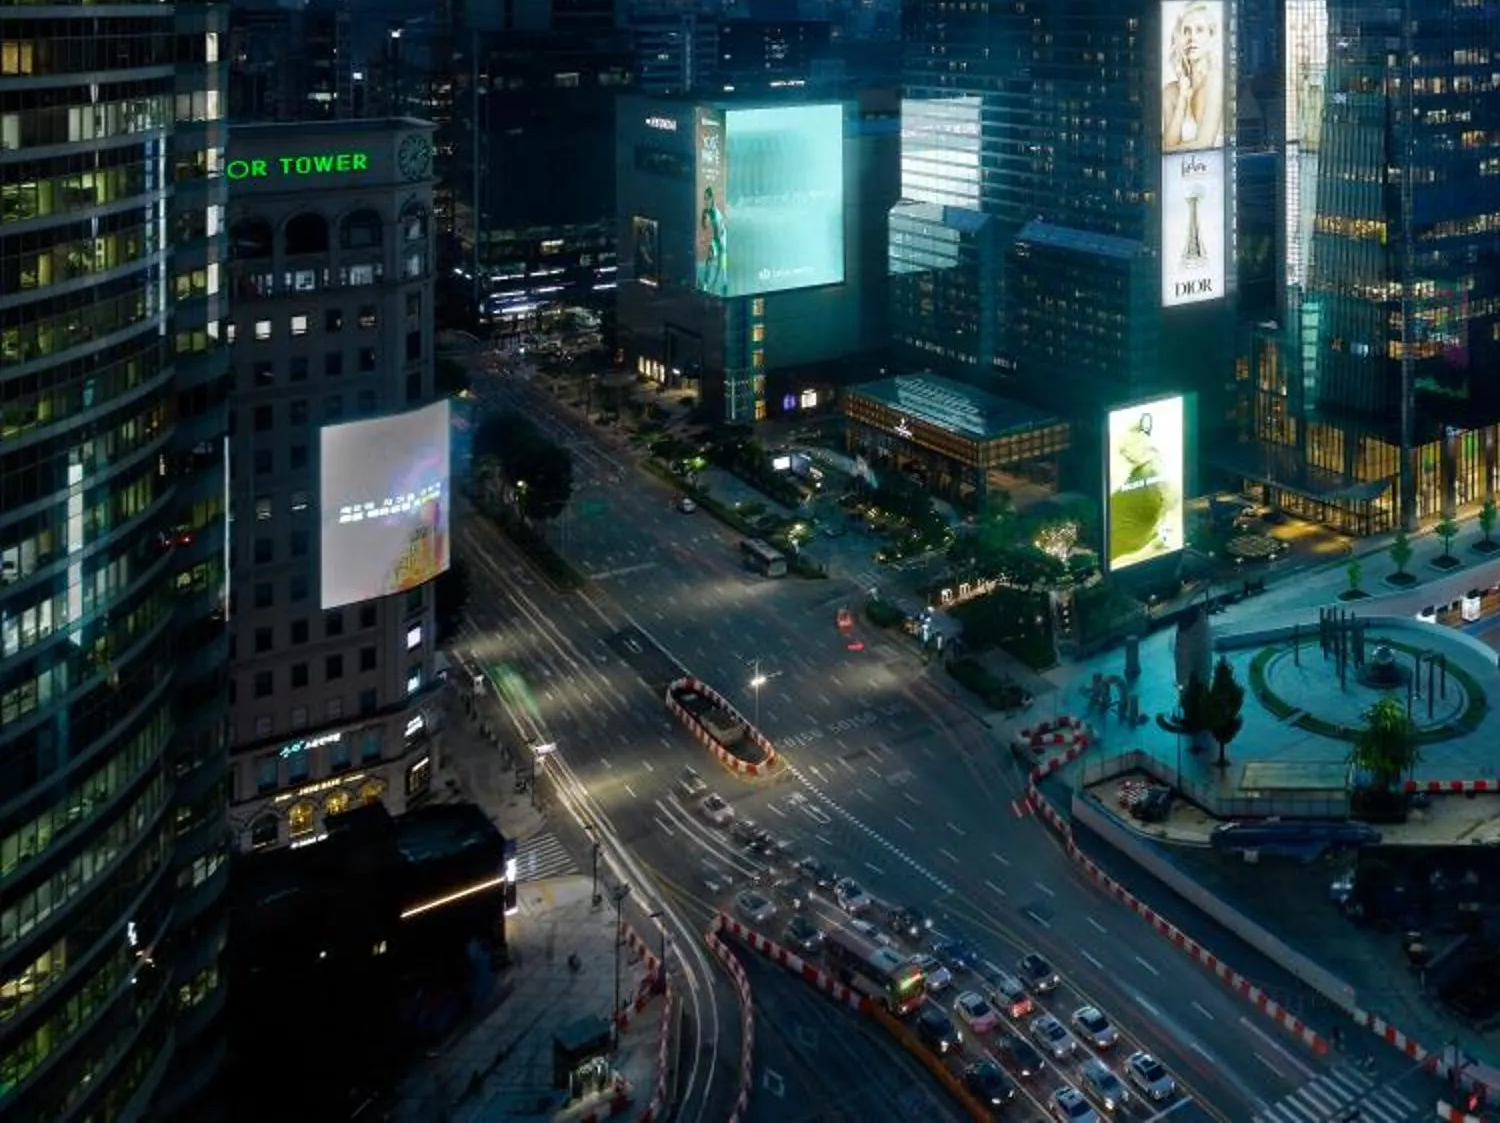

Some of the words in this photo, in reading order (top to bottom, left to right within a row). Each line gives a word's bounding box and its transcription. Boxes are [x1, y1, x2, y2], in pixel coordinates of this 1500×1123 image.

[227, 160, 268, 179] OR
[280, 154, 368, 174] TOWER
[1174, 278, 1213, 298] DIOR
